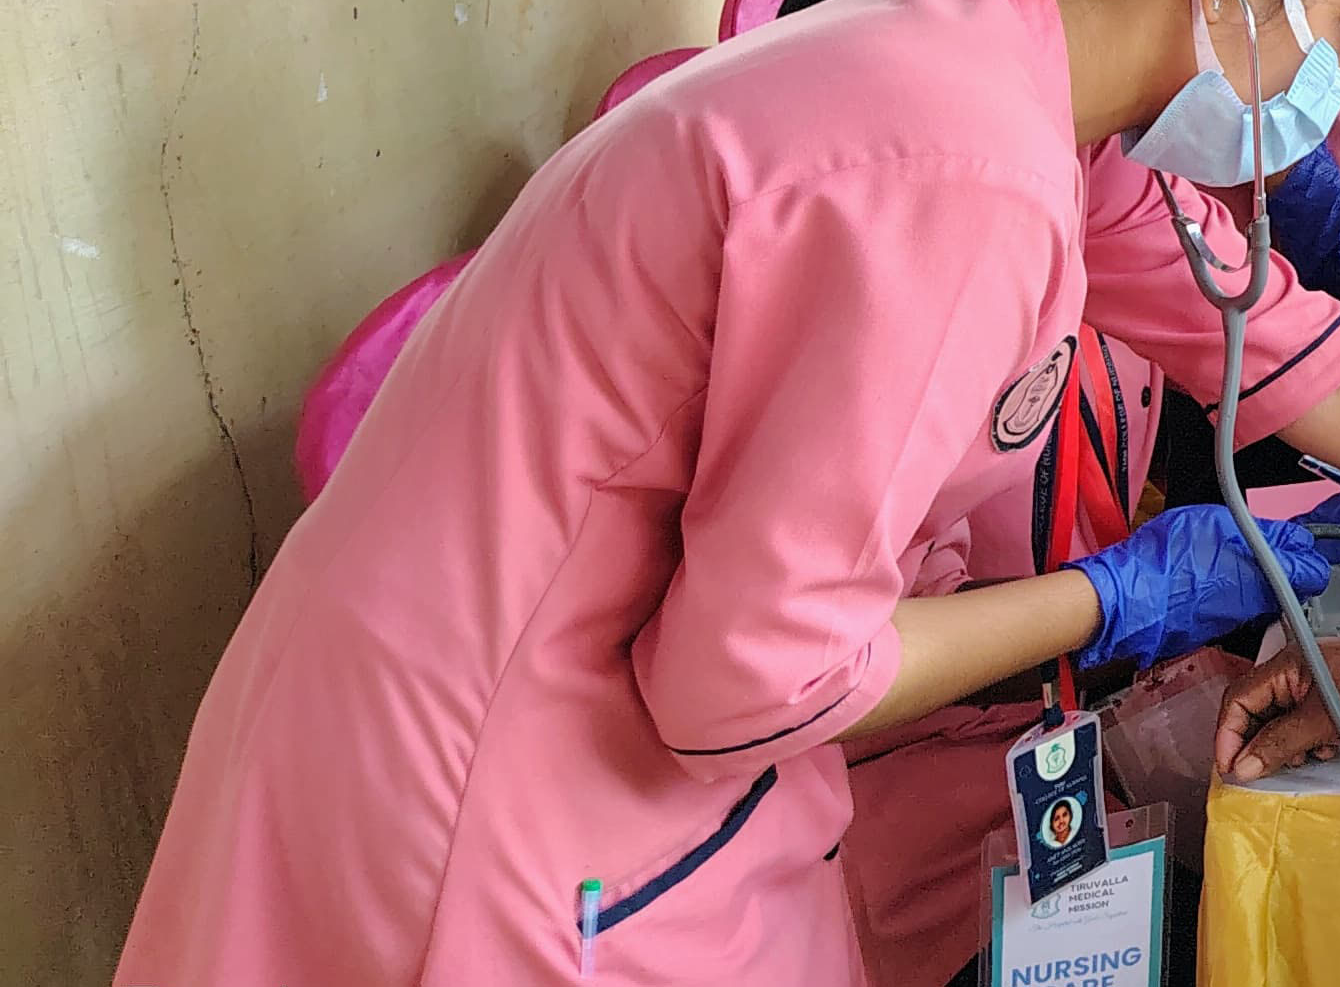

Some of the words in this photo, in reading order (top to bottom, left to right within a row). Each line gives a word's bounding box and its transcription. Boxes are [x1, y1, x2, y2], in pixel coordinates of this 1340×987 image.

[1070, 875, 1129, 893] TIRUVALLA
[1068, 888, 1115, 903] MEDICAL
[1068, 900, 1110, 914] MISSION
[1011, 947, 1142, 987] NURSING
